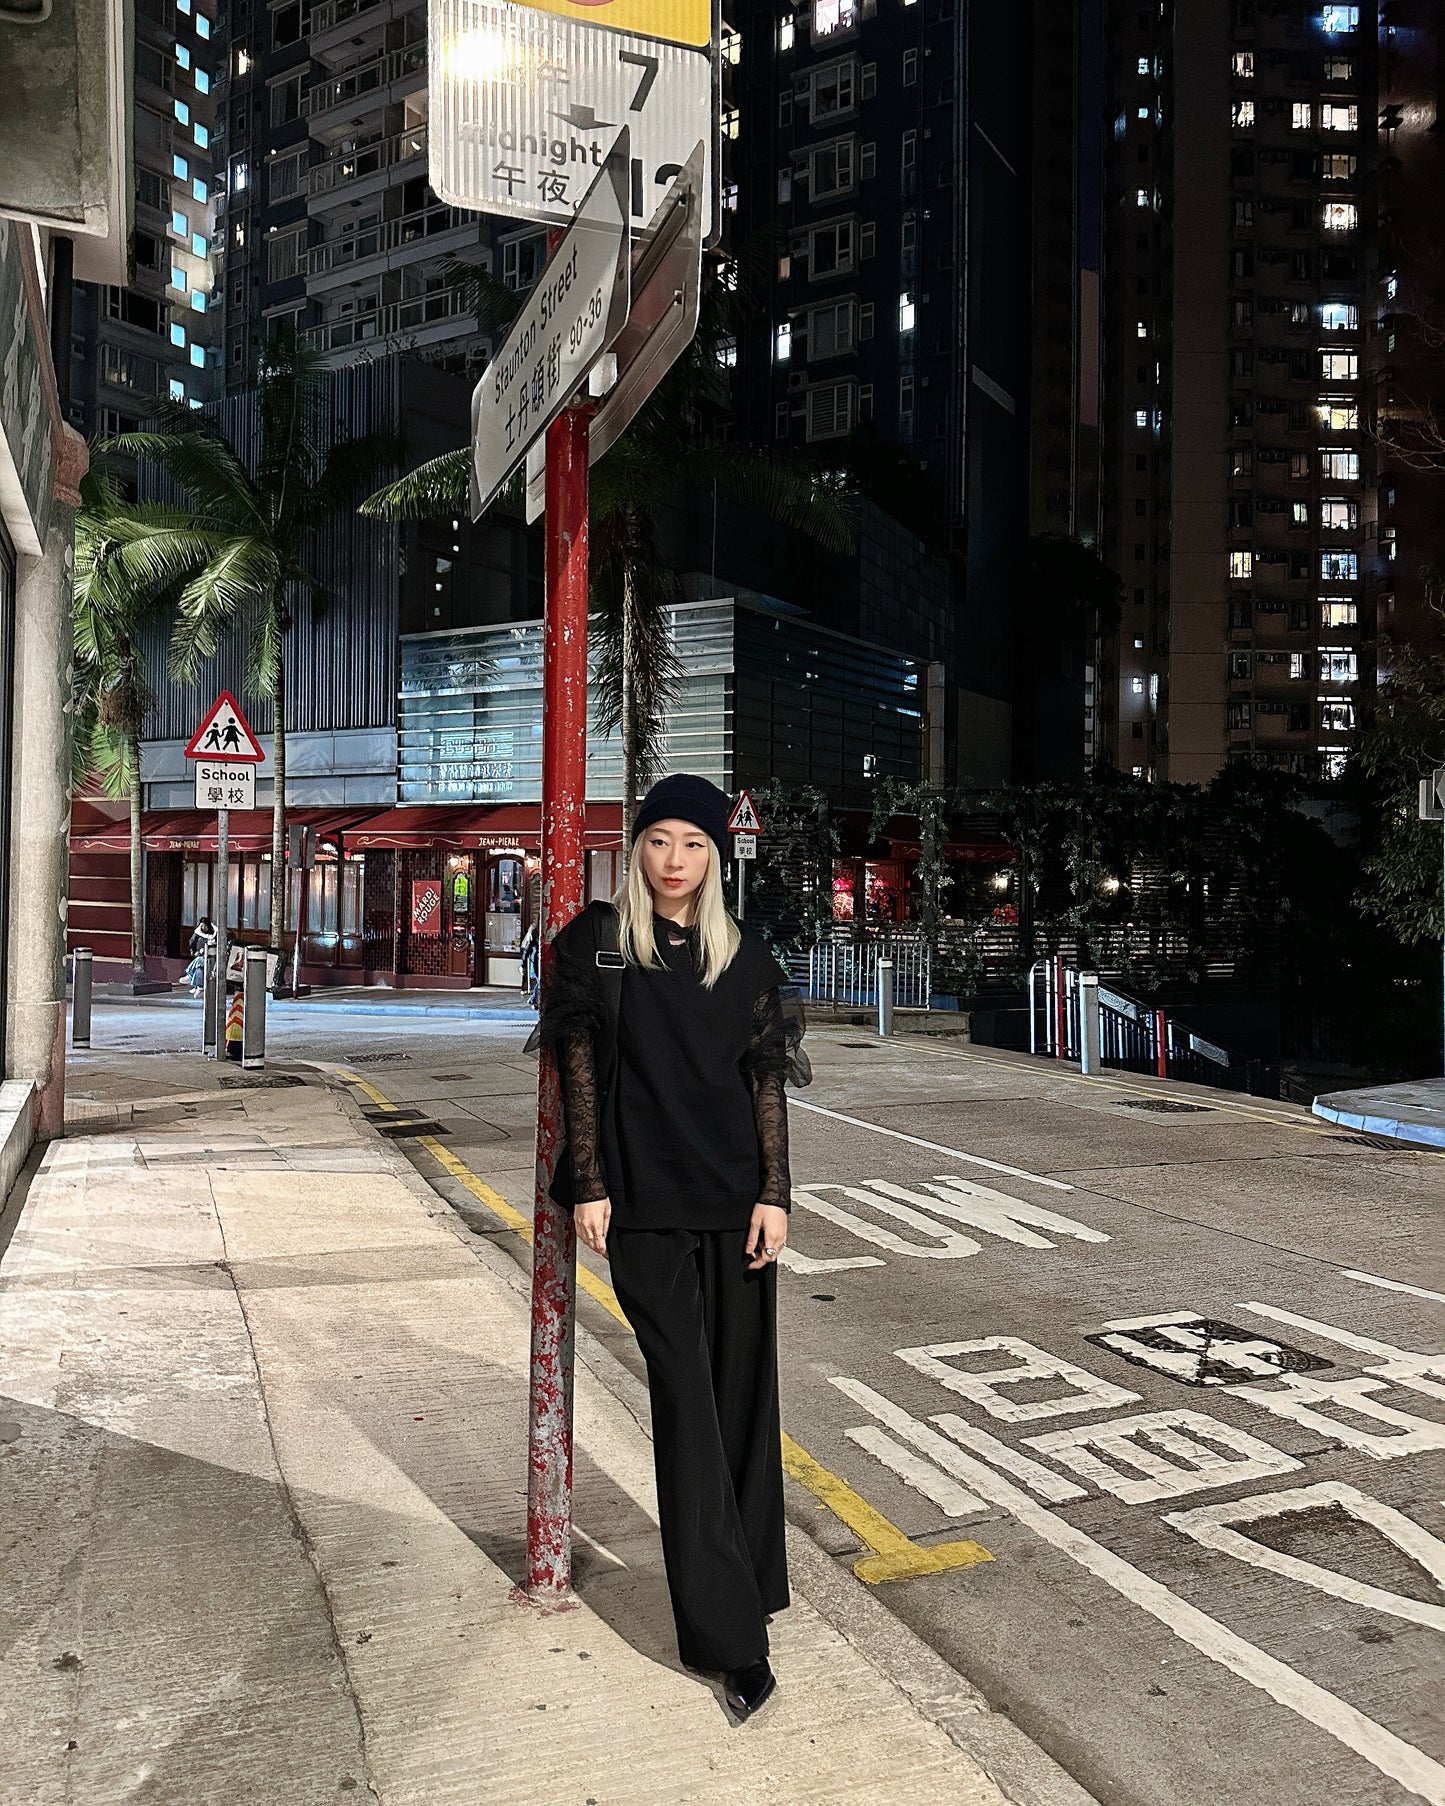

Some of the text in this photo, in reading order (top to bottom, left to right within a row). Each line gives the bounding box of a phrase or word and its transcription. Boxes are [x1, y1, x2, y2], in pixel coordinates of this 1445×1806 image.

[619, 49, 659, 112] 7
[495, 242, 578, 405] Staunton Street
[570, 287, 602, 355] 90-36
[504, 332, 561, 453] 士丹頓街
[201, 768, 250, 781] School
[207, 786, 244, 804] 學校
[478, 836, 520, 847] JEAN-PIERRE
[736, 837, 755, 845] School
[413, 887, 435, 918] MARDI
[417, 893, 440, 925] ROUGE
[776, 1174, 1114, 1275] LOW
